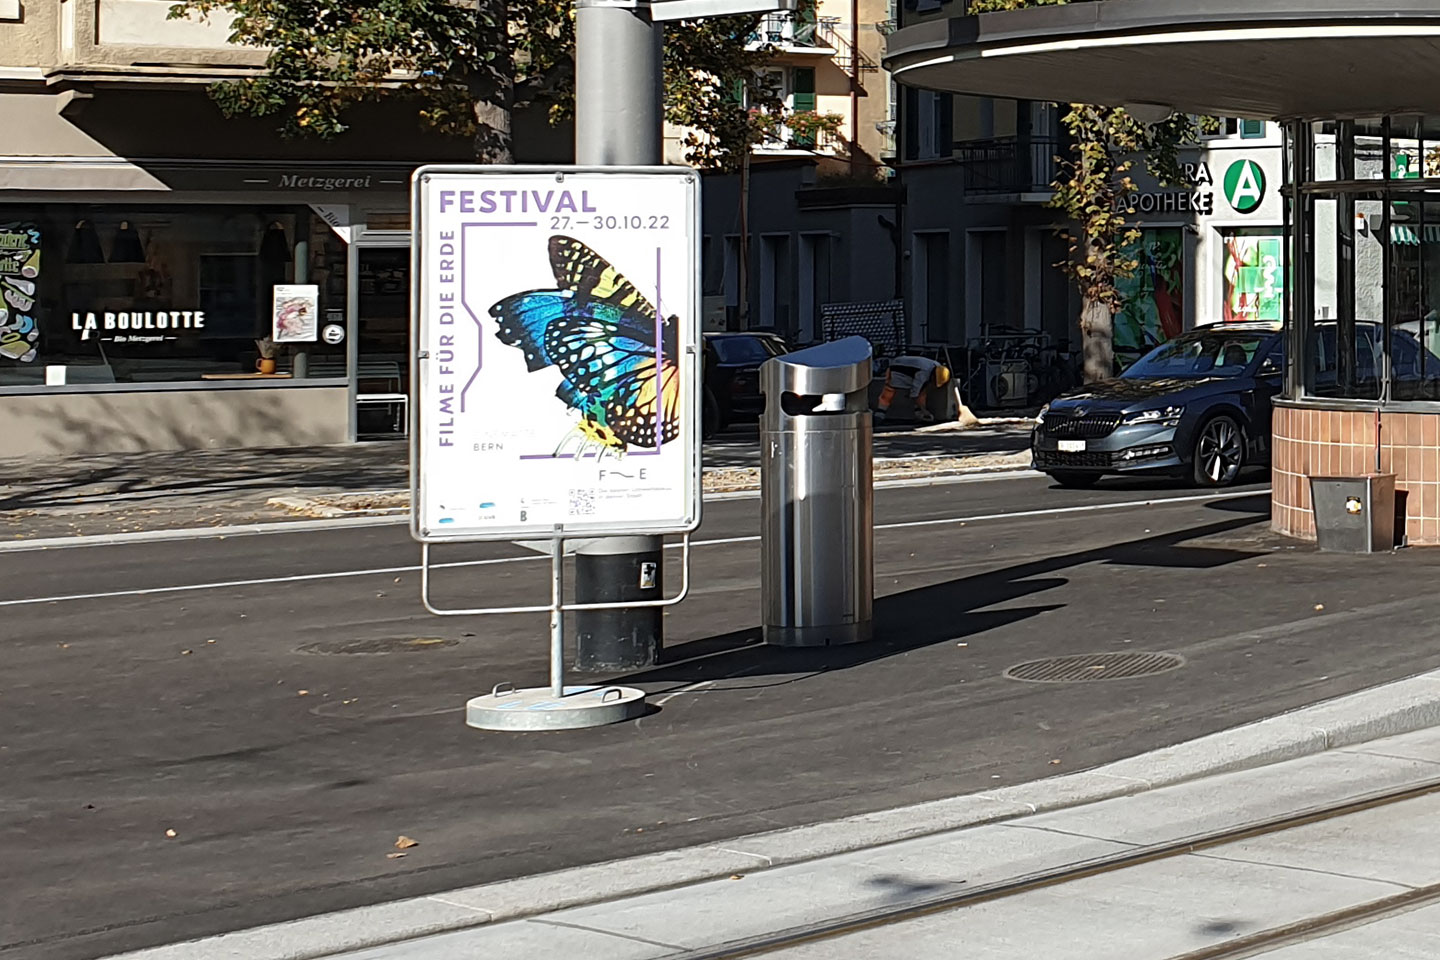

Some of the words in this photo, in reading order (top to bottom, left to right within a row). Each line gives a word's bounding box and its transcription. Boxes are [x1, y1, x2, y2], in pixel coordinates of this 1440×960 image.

[278, 174, 372, 191] Metzgerei
[1231, 159, 1263, 209] A
[439, 190, 597, 213] FESTIVAL
[1116, 191, 1212, 212] APOTHEKE
[439, 230, 455, 283] ERDE
[439, 292, 455, 328] DIE
[72, 312, 97, 336] LA
[104, 311, 205, 329] BOULOTTE
[435, 334, 455, 376] FÜR
[439, 384, 455, 447] FILME
[473, 442, 504, 452] BERN
[598, 469, 606, 481] F
[639, 467, 647, 480] E
